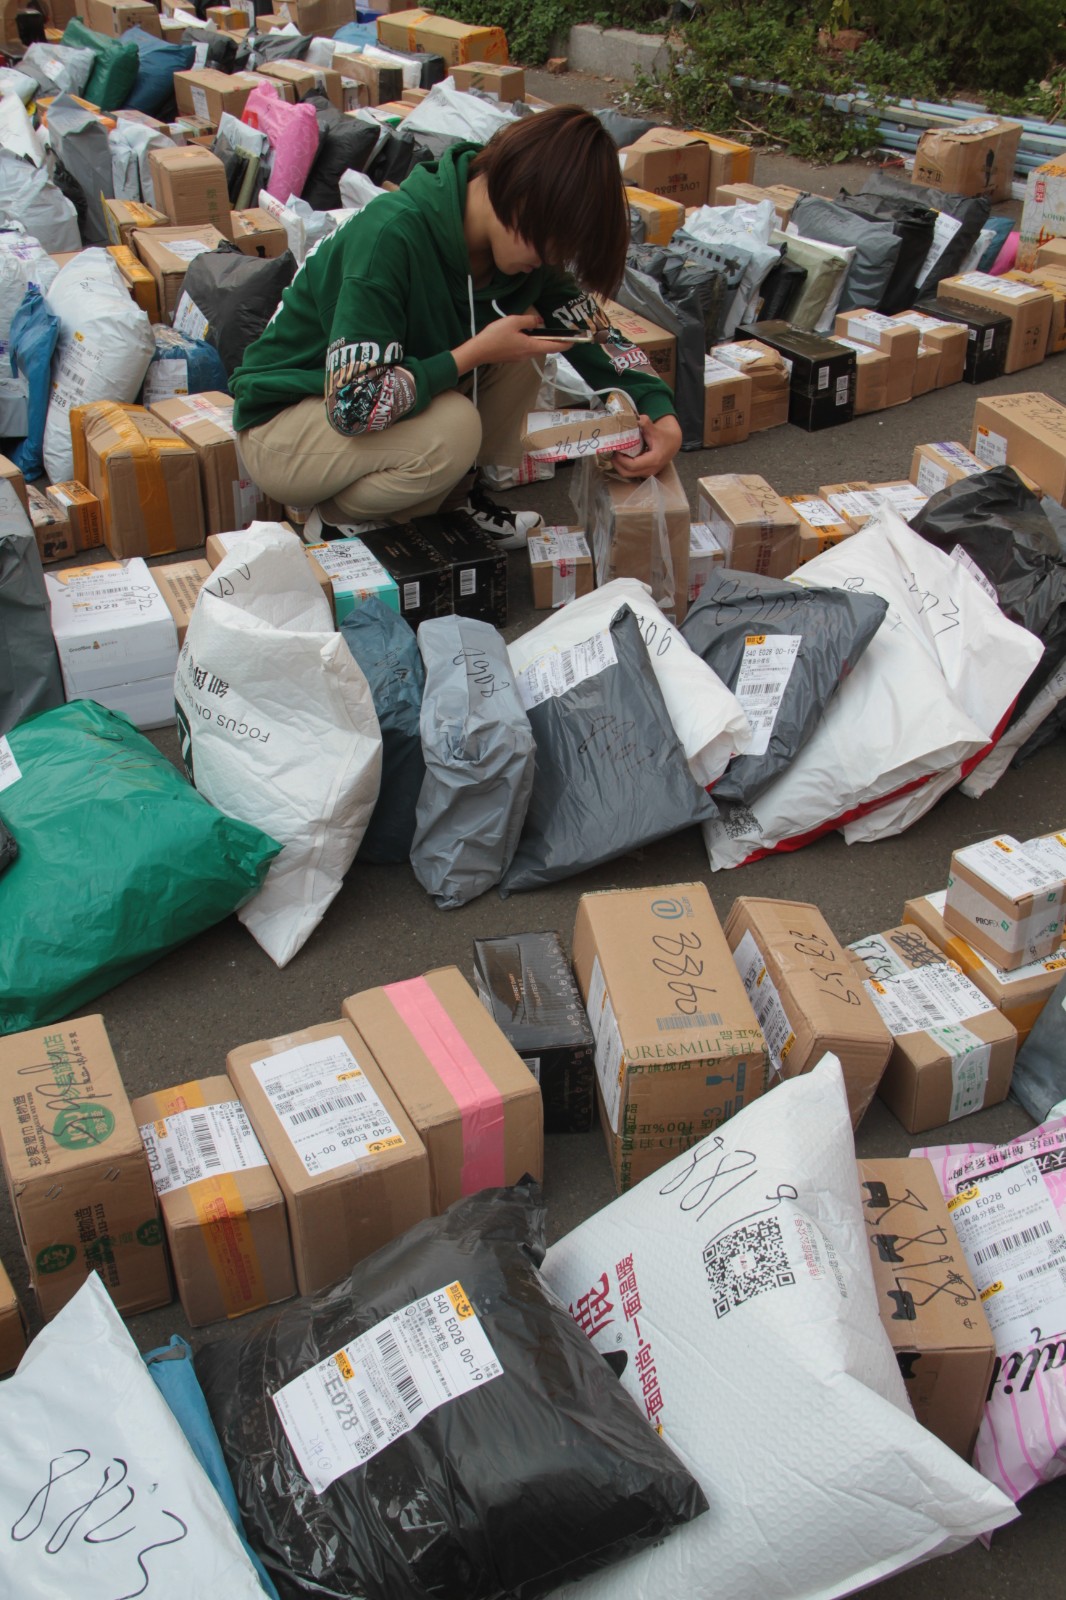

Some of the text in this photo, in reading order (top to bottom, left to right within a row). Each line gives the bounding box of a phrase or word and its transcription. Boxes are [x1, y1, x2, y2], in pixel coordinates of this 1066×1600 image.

[195, 702, 212, 720] ON
[216, 714, 271, 744] FOCUS
[953, 973, 990, 1010] E028 00-19
[143, 1136, 162, 1173] E028
[304, 1125, 393, 1162] 540 E028 00-19
[953, 1174, 1039, 1221] 540 E028 00-19
[963, 1202, 1006, 1226] 青岛分拨包
[424, 1308, 449, 1352] 青岛分拨包
[433, 1294, 484, 1381] 540 E028 00-19
[324, 1375, 359, 1431] E028
